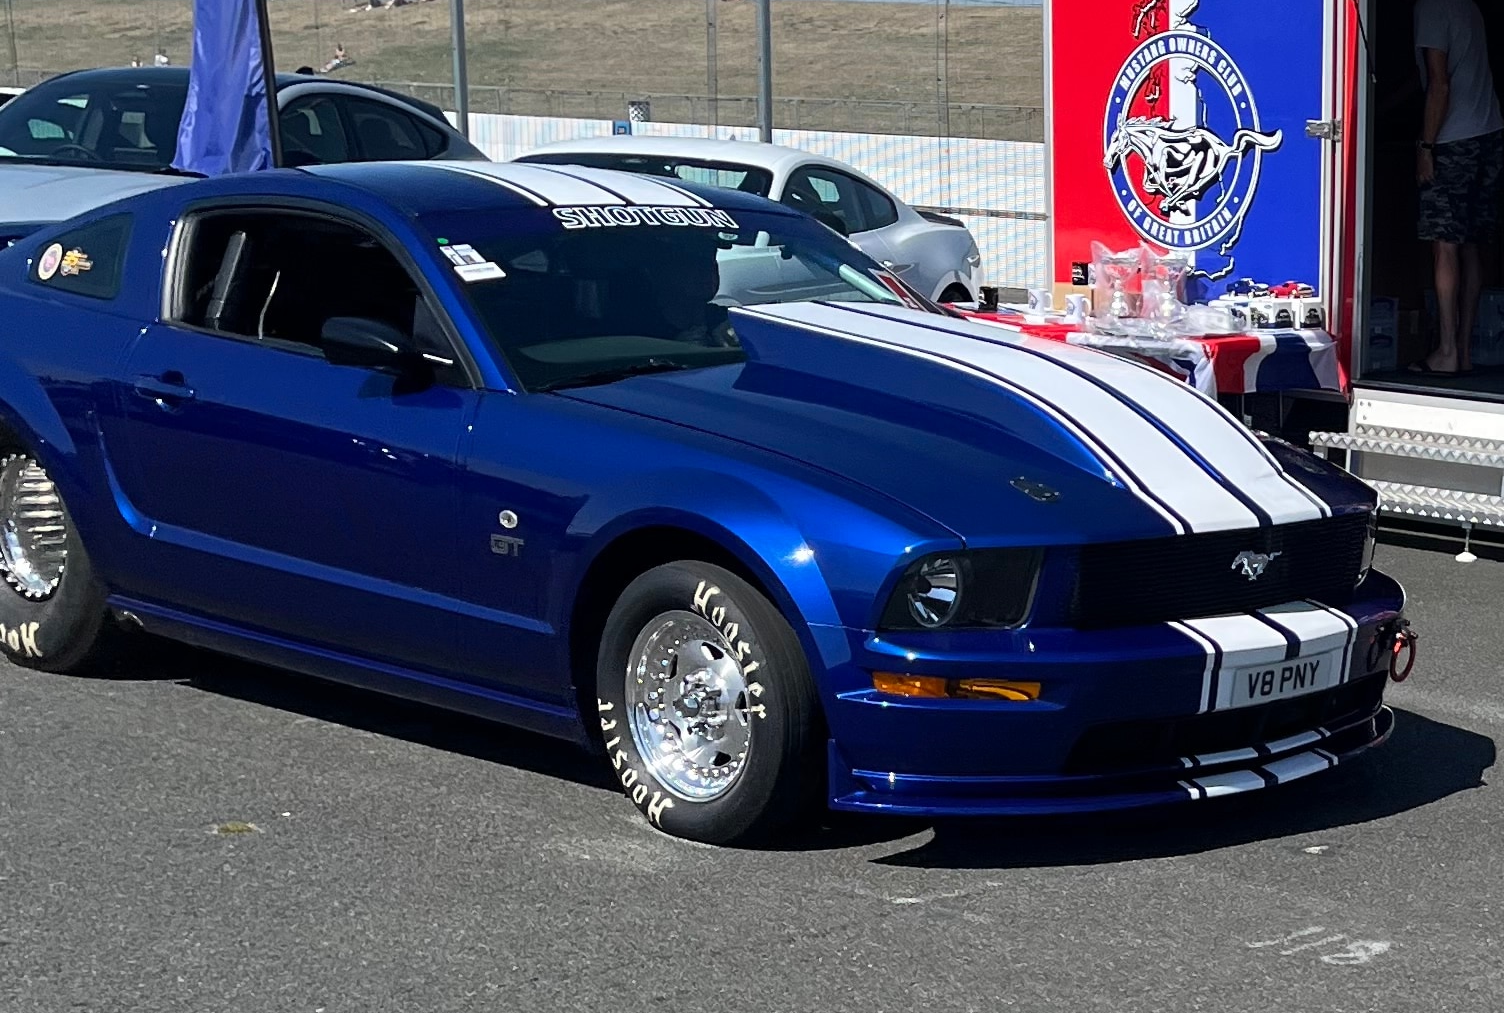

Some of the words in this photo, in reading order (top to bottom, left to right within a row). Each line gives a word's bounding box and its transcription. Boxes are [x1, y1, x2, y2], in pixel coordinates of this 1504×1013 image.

[1119, 40, 1167, 91] MUSTANG
[1169, 37, 1217, 62] OWNERS
[1216, 61, 1243, 97] CLUB
[552, 206, 740, 229] SHOTGUN
[1127, 201, 1142, 219] OF
[1143, 219, 1181, 244] GREAT
[1184, 206, 1233, 245] BRITAIN
[690, 580, 767, 719] Hoosier
[1248, 671, 1275, 699] V8
[1280, 660, 1320, 693] PNY
